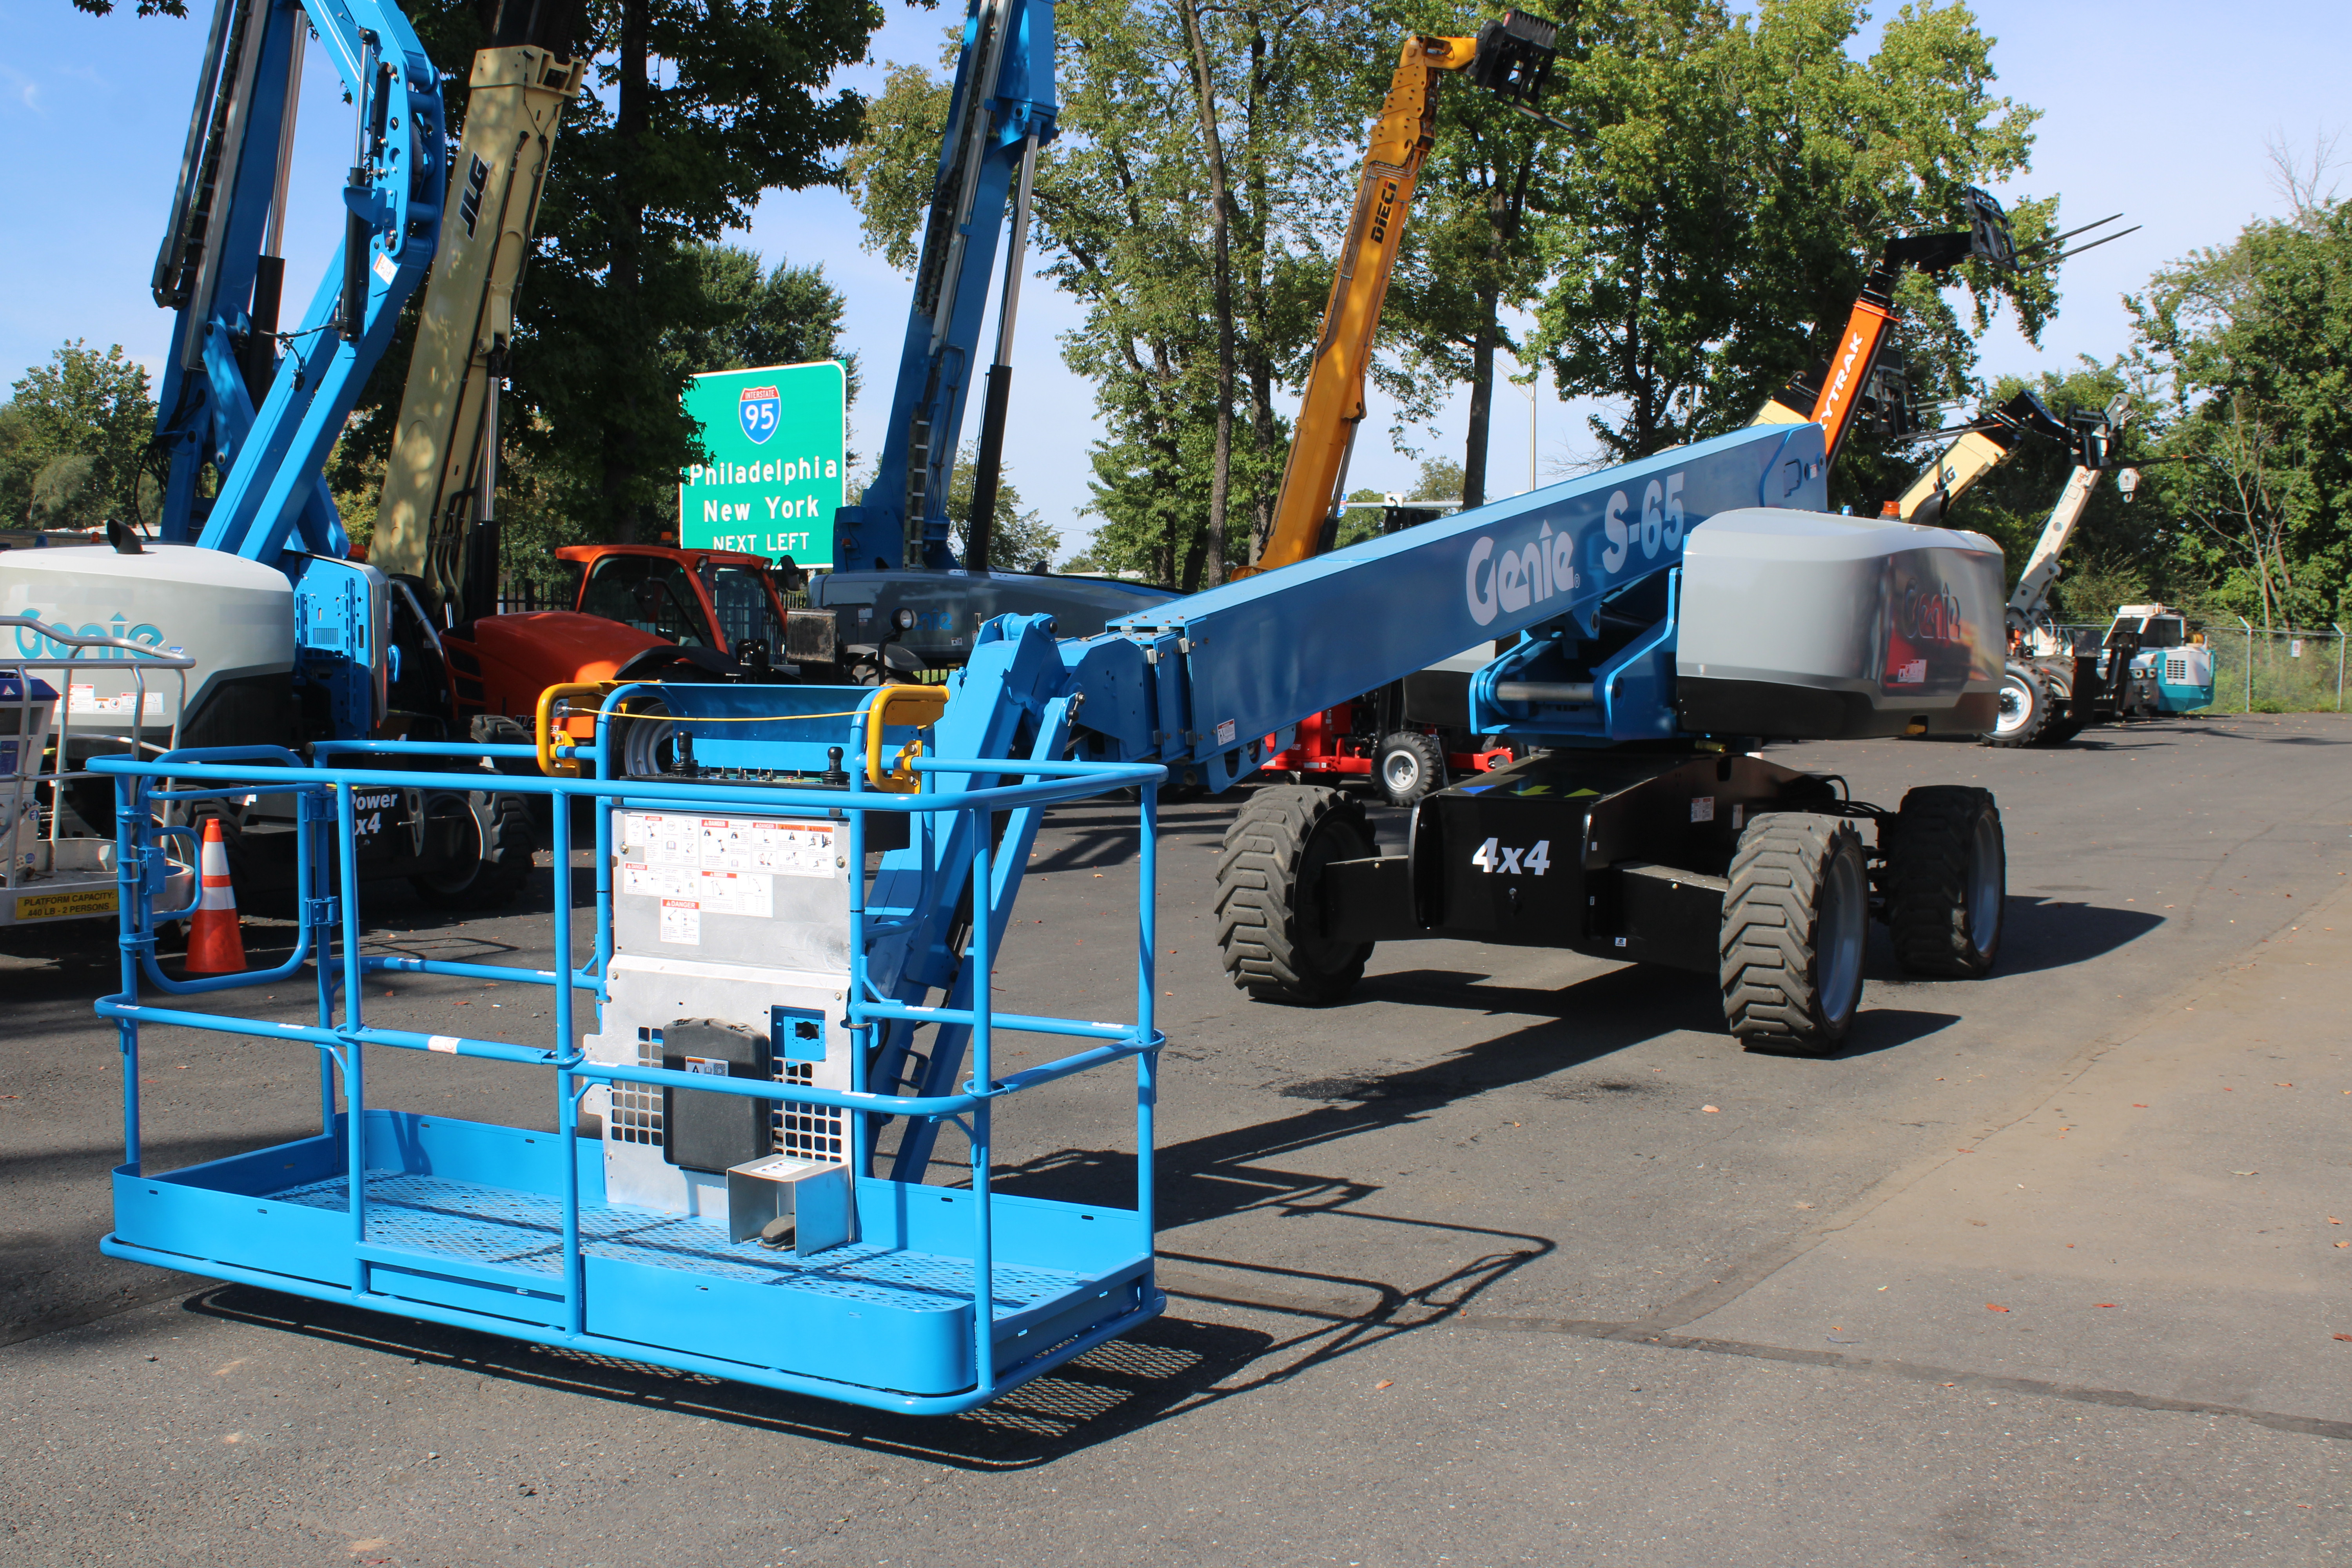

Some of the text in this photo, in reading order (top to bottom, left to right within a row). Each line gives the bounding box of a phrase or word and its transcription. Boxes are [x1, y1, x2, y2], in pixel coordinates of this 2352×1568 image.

[460, 151, 489, 241] JLG
[745, 389, 775, 399] INTERSTATE
[1818, 331, 1863, 431] KYTRAK
[746, 403, 774, 430] 95
[690, 456, 837, 486] Philadelphia
[704, 495, 819, 522] New York
[1602, 472, 1684, 574] S-65
[713, 532, 809, 552] NEXT LEFT
[1466, 519, 1575, 626] Genie
[15, 608, 166, 659] Genie
[354, 812, 381, 836] x4
[1472, 837, 1550, 875] 4x4
[24, 892, 114, 906] PLATFORM CAPACITY:
[44, 907, 55, 916] LB
[70, 903, 110, 913] PERSONS
